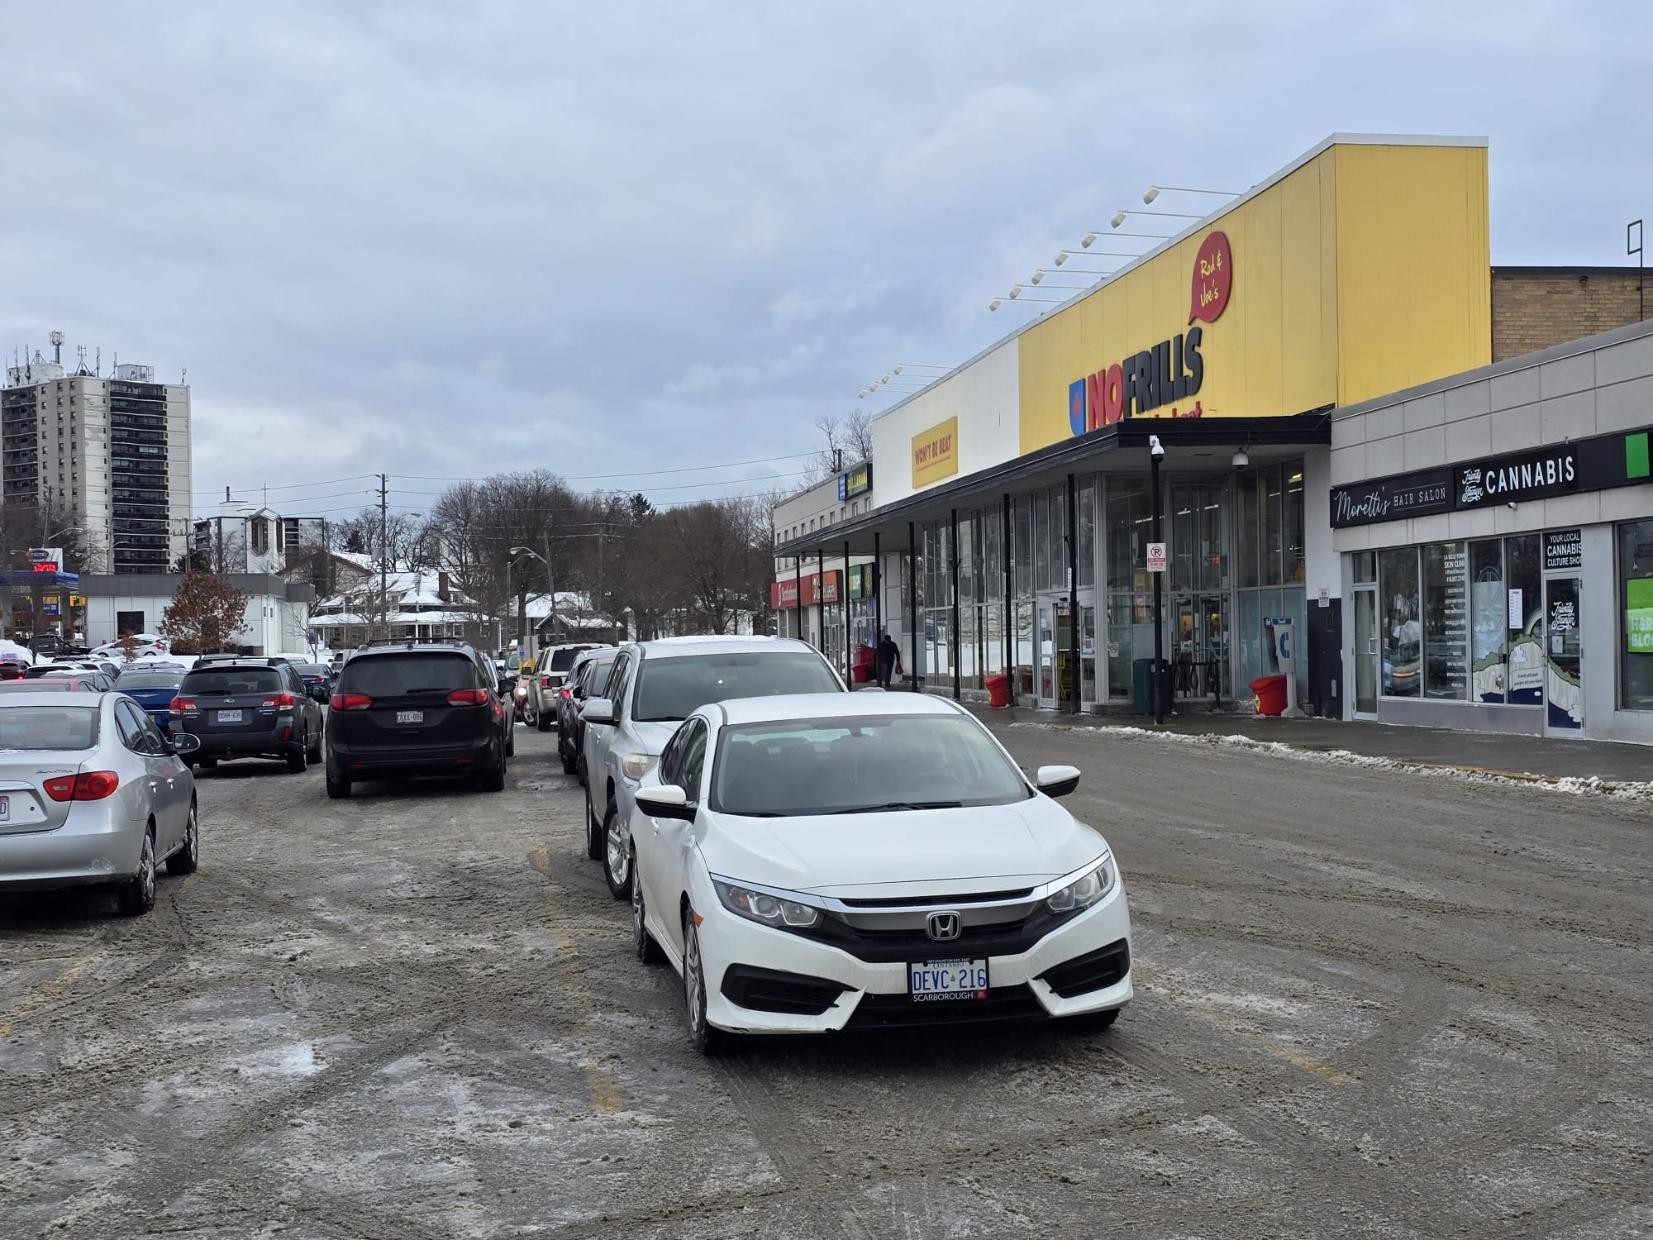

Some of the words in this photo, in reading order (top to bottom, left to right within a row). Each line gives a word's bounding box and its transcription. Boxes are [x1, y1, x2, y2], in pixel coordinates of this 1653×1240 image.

[1200, 278, 1219, 307] Joe's
[1485, 456, 1575, 494] CANNABIS
[1333, 485, 1392, 522] Moretti's
[1393, 493, 1414, 507] HAIR
[1418, 487, 1446, 503] SALON
[1550, 534, 1564, 543] YOUR
[1563, 532, 1580, 542] LOCAL
[1547, 543, 1582, 557] CANNABIS
[1547, 557, 1569, 567] CULTURE
[1569, 556, 1581, 565] SHO
[913, 992, 973, 1002] SCARBOROUGH
